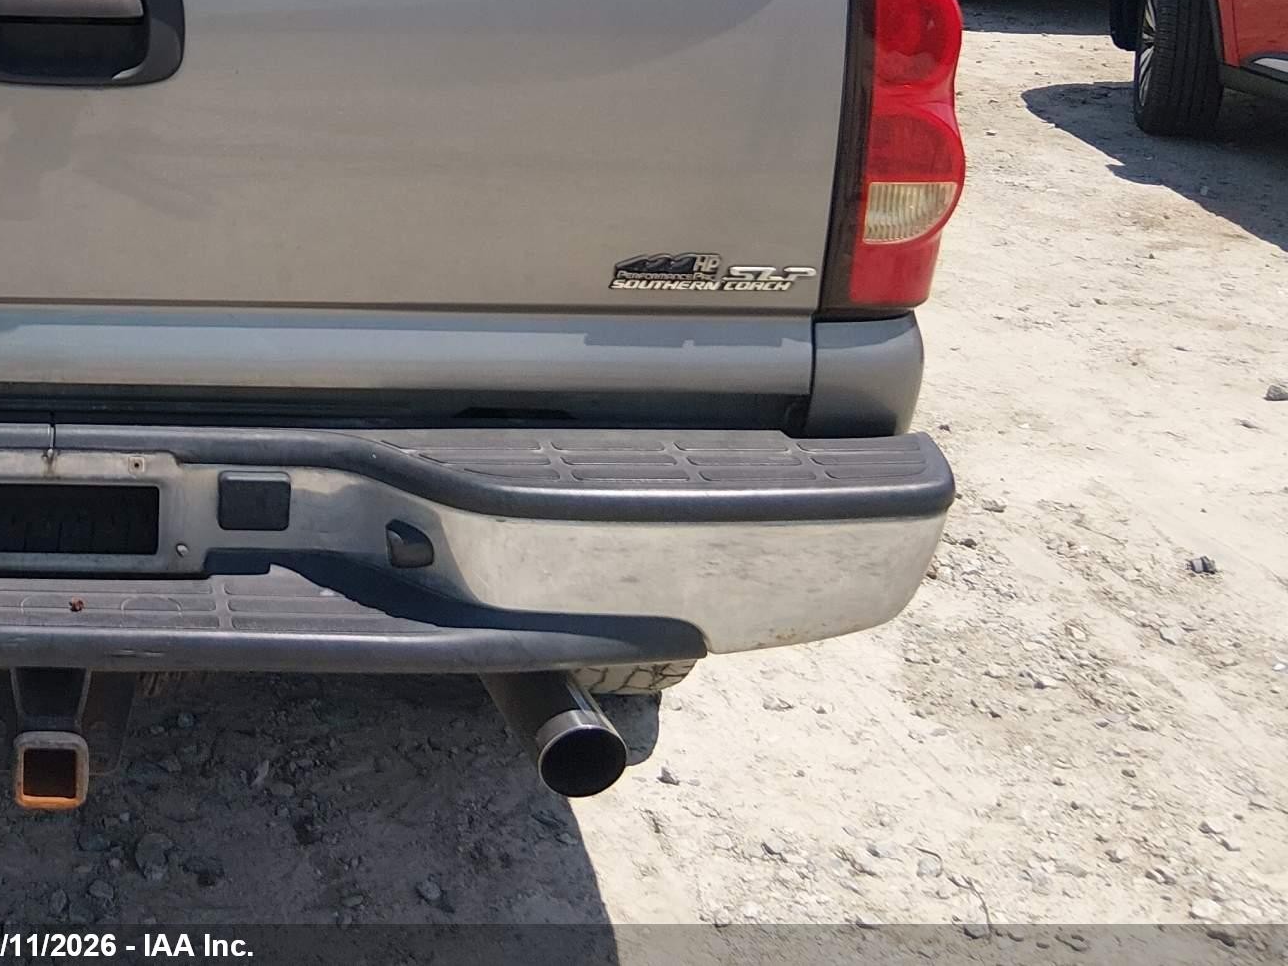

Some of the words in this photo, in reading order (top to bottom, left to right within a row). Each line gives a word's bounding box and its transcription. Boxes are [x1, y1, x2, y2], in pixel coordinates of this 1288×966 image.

[693, 254, 720, 272] HP
[610, 279, 721, 291] SOUTHERN
[723, 280, 792, 291] COACH
